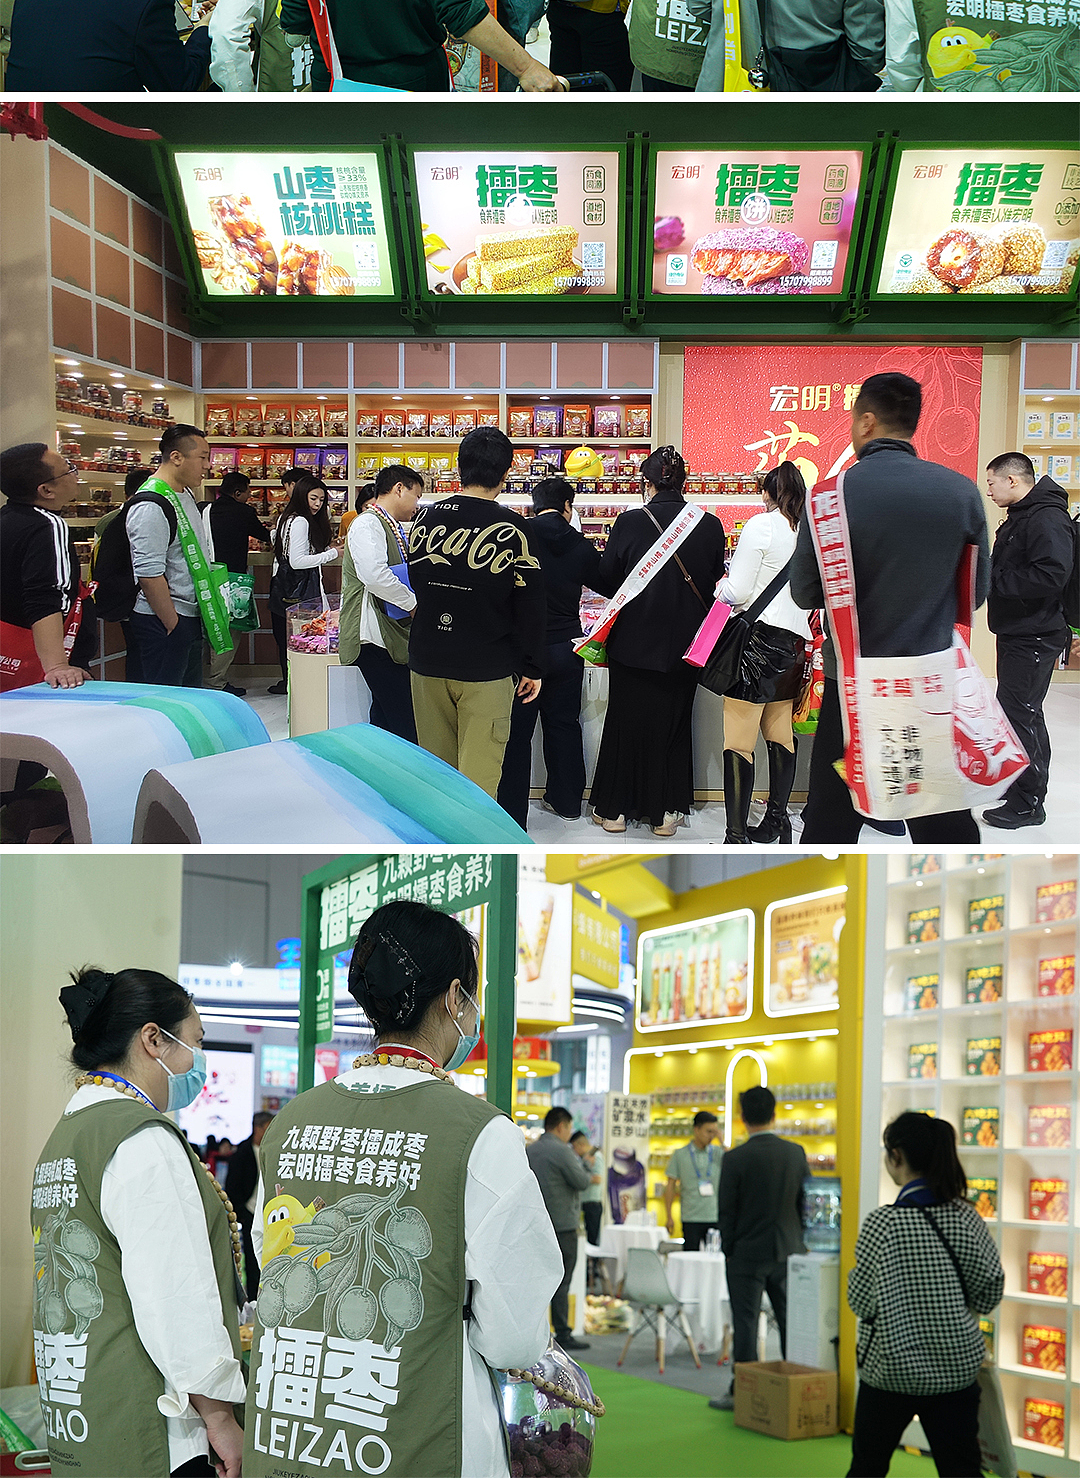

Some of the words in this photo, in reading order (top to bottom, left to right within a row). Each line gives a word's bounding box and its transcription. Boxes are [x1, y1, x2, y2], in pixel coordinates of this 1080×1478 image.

[654, 18, 711, 47] LEIZ
[193, 167, 223, 182] 宏明
[273, 165, 336, 200] 山枣
[430, 167, 460, 181] 宏明
[671, 165, 700, 180] 宏明
[714, 163, 801, 207] 擂枣
[912, 164, 943, 179] 宏明
[952, 162, 1045, 207] 擂枣
[475, 164, 559, 208] 擂枣
[279, 201, 376, 236] 核桃糕
[714, 208, 741, 224] 食养擂枣
[950, 208, 1034, 224] 食养擂枣认准宏明
[553, 275, 606, 287] 15707998899
[779, 275, 832, 286] 15707998899
[769, 383, 831, 411] 宏明
[435, 503, 460, 512] TIDE
[282, 1124, 429, 1162] 九颗野枣擂成枣
[277, 1151, 422, 1191] 宏明擂枣食养好
[255, 1326, 402, 1433] 擂枣
[254, 1416, 393, 1476] LEIZAO
